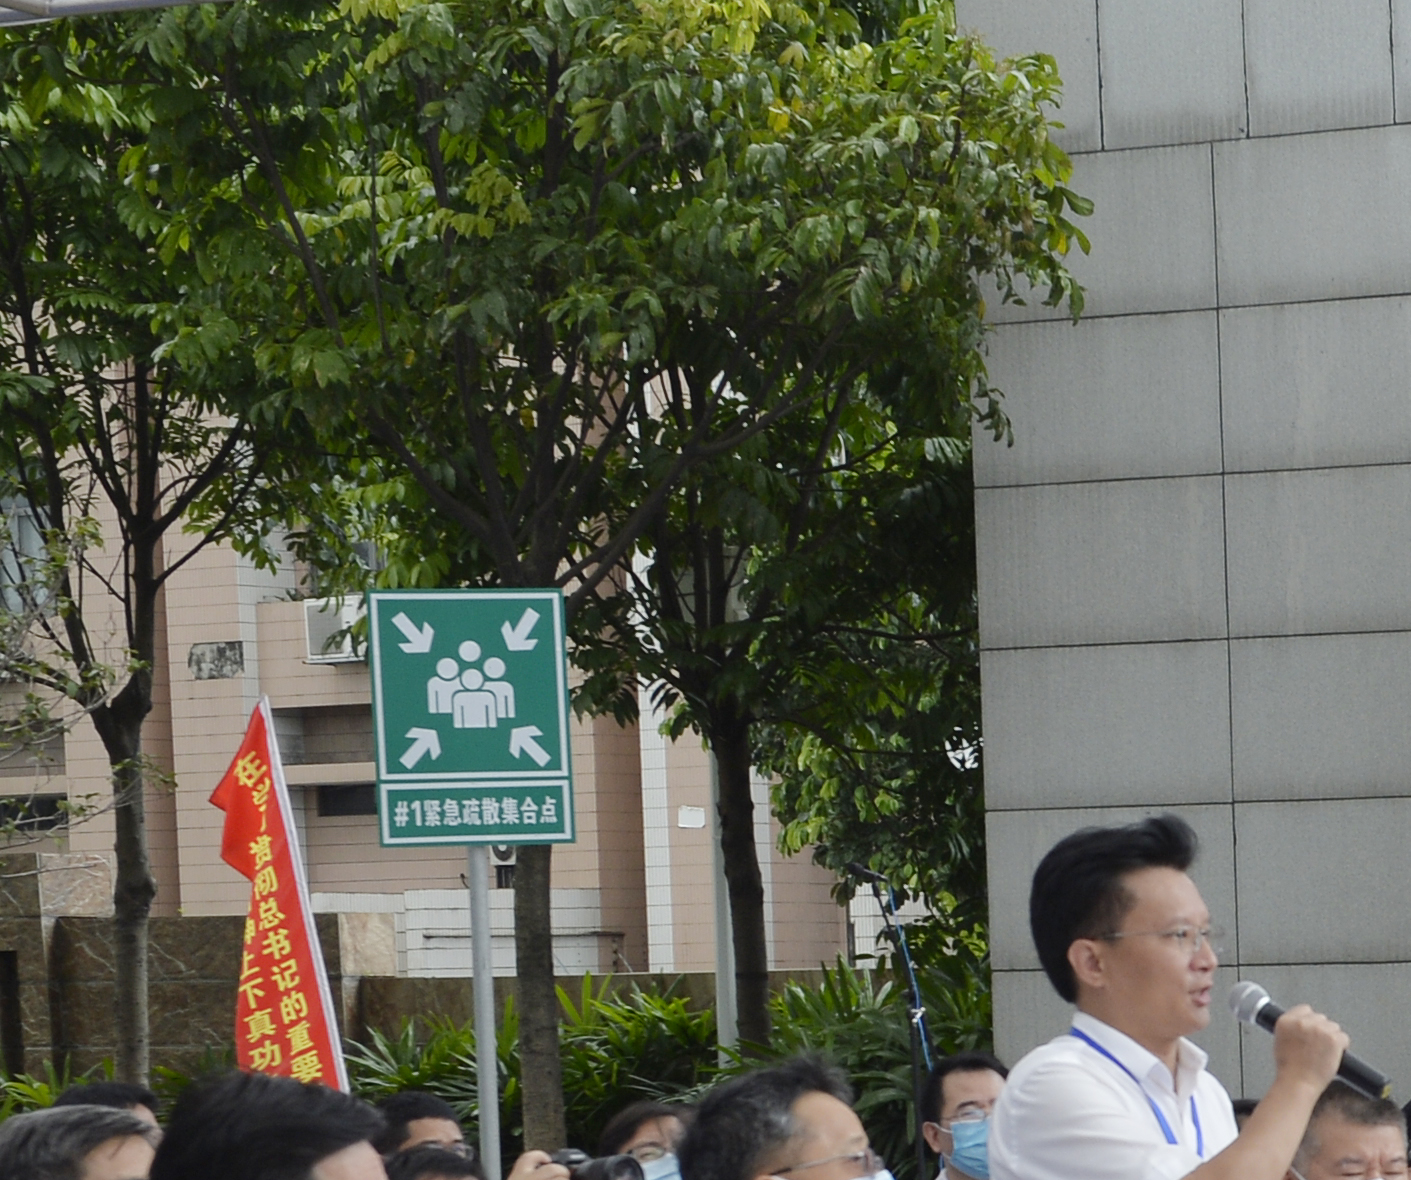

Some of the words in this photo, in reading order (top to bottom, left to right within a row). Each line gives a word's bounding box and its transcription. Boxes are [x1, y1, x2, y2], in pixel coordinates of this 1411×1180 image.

[394, 796, 558, 827] #1紧急疏散集合点
